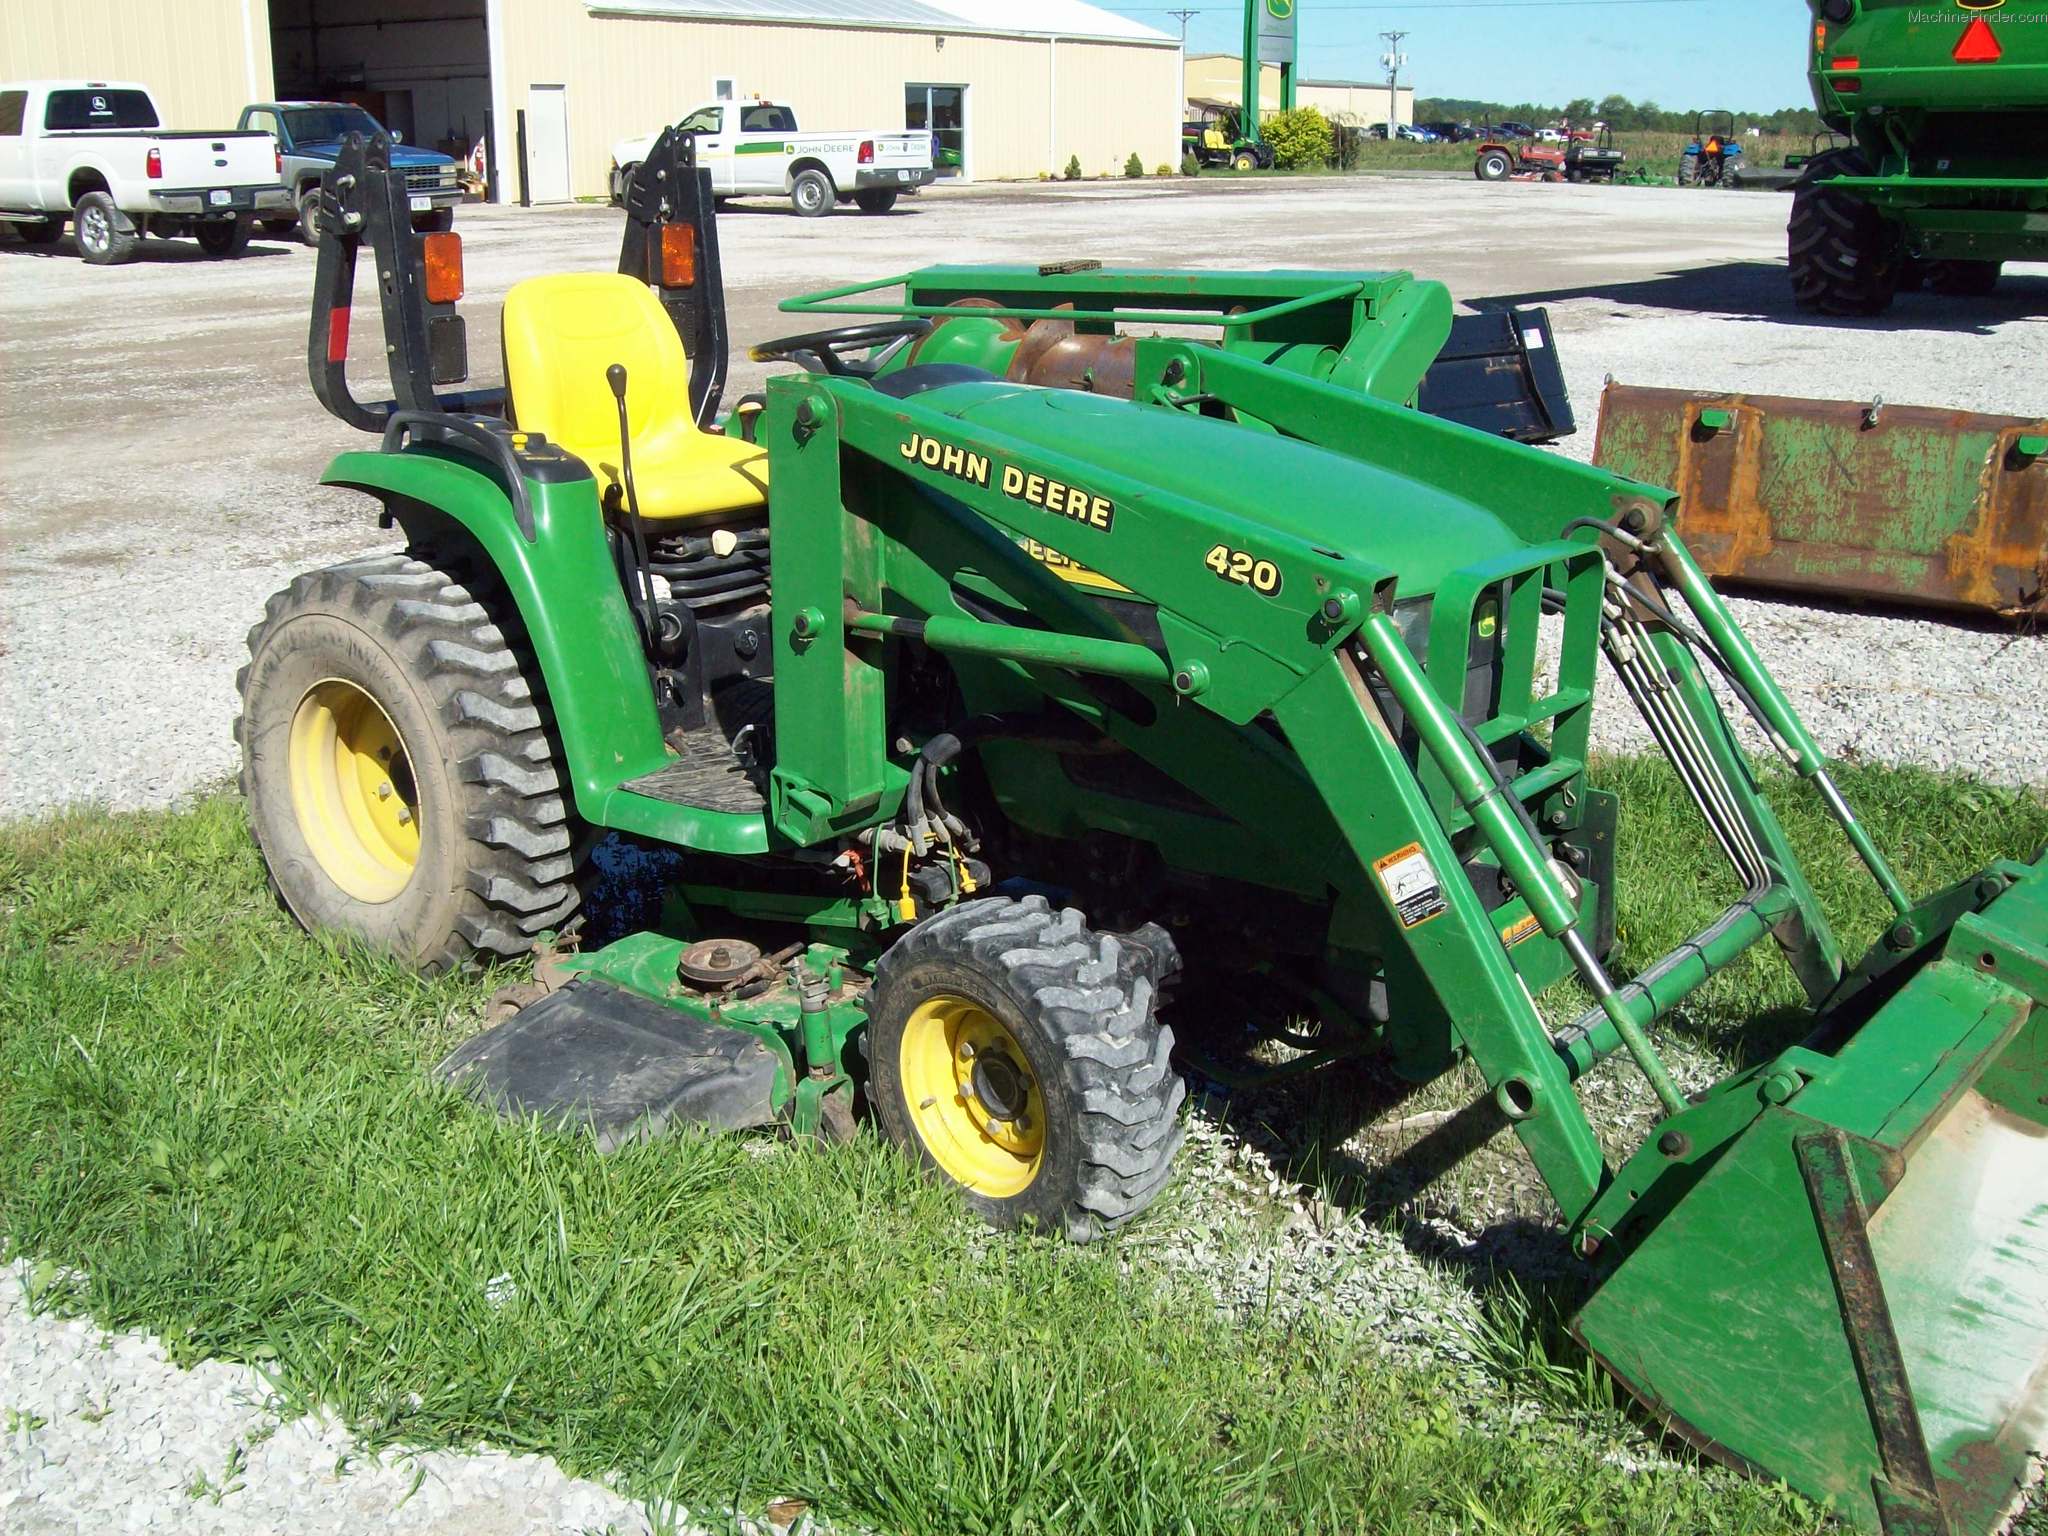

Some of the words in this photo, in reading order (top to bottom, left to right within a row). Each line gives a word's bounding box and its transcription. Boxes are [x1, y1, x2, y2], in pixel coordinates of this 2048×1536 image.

[797, 145, 821, 154] JOHN
[823, 143, 855, 153] DEERE
[901, 433, 991, 488] JOHN
[1003, 465, 1115, 532] DEERE
[1205, 544, 1282, 596] 420
